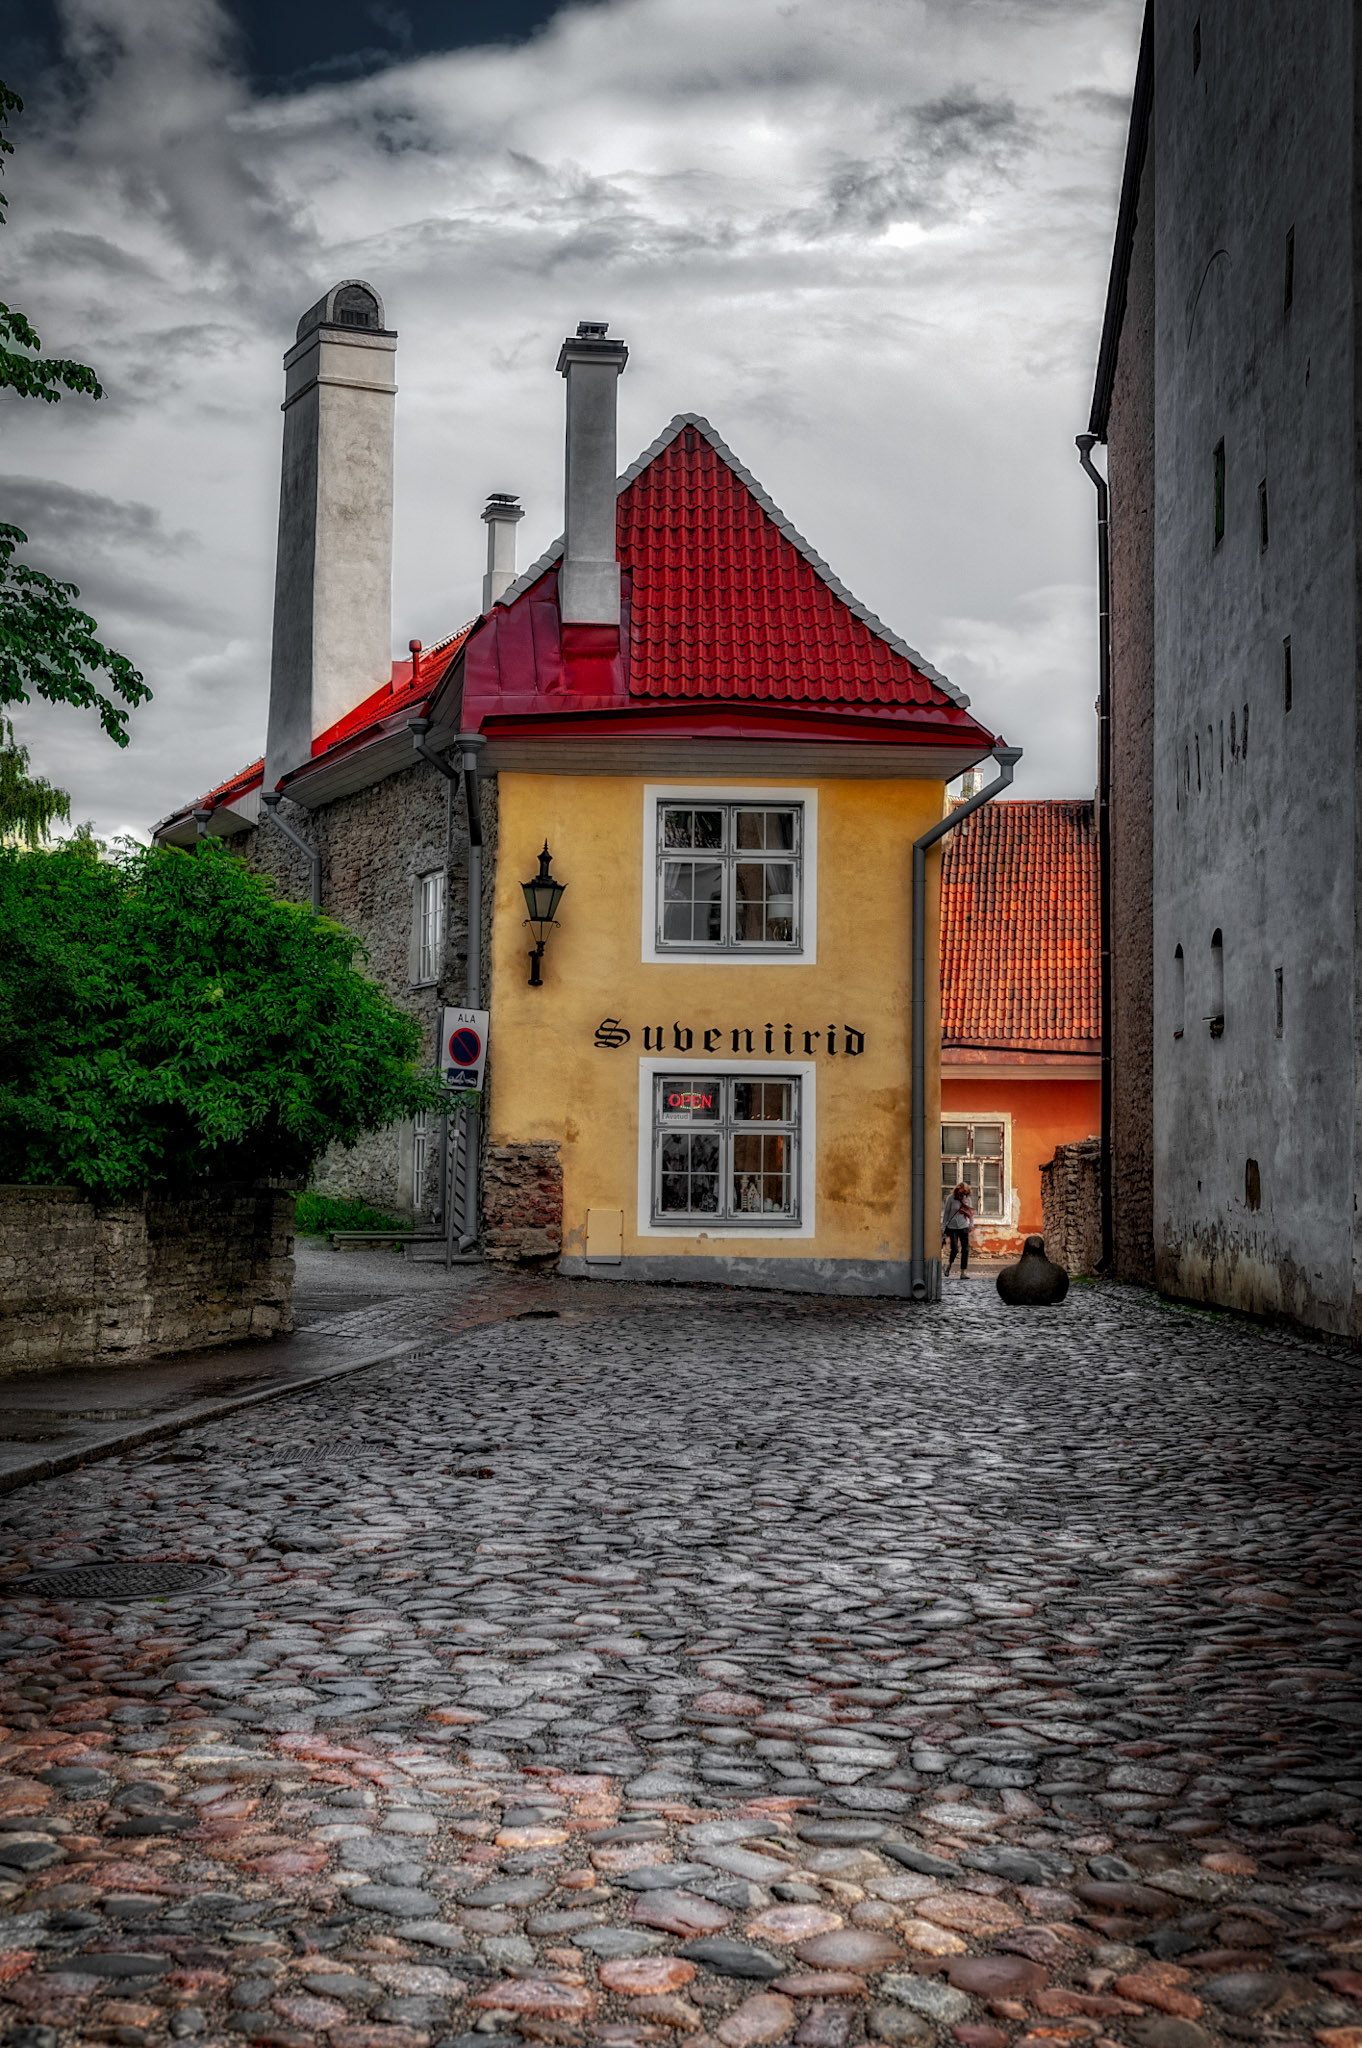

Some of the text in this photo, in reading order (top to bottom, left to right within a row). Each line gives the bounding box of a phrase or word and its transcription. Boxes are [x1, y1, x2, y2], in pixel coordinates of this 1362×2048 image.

[457, 1013, 476, 1023] ALA
[594, 1017, 866, 1057] Suveniirid
[668, 1093, 713, 1109] OPEN
